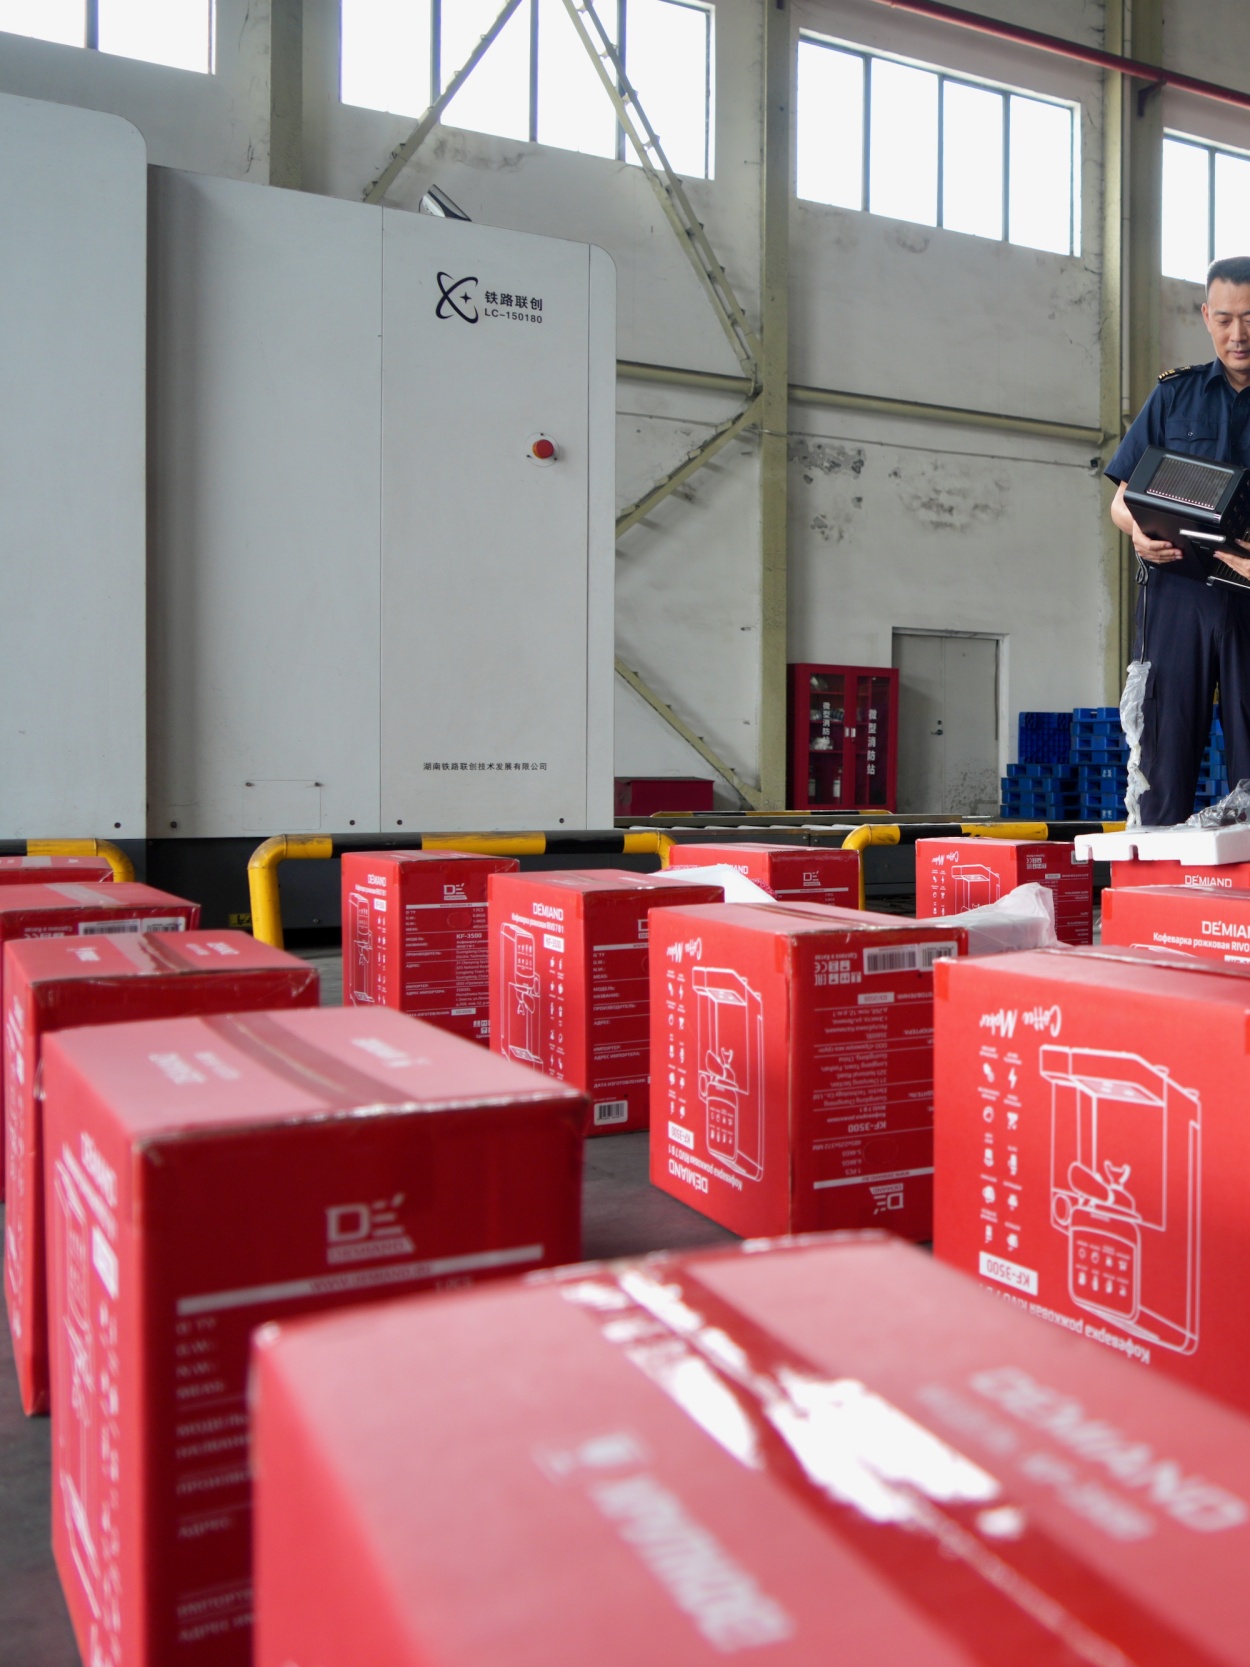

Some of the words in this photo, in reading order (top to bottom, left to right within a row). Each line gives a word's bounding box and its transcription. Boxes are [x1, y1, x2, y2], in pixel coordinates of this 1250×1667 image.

[485, 291, 543, 311] 铁路联创
[485, 308, 542, 323] LC-150180
[867, 709, 877, 775] 微型消防站
[423, 762, 547, 771] 湖南铁路联创技术发展有限公司
[1153, 932, 1192, 947] Кофеварка
[1193, 938, 1230, 950] рожковая
[1231, 941, 1250, 952] RIVO
[979, 1008, 1018, 1039] Maker
[1022, 1005, 1062, 1038] Coffee
[848, 1121, 886, 1133] KF-3500
[986, 1258, 1031, 1288] KF-3500
[1085, 1325, 1150, 1365] Кофеварка
